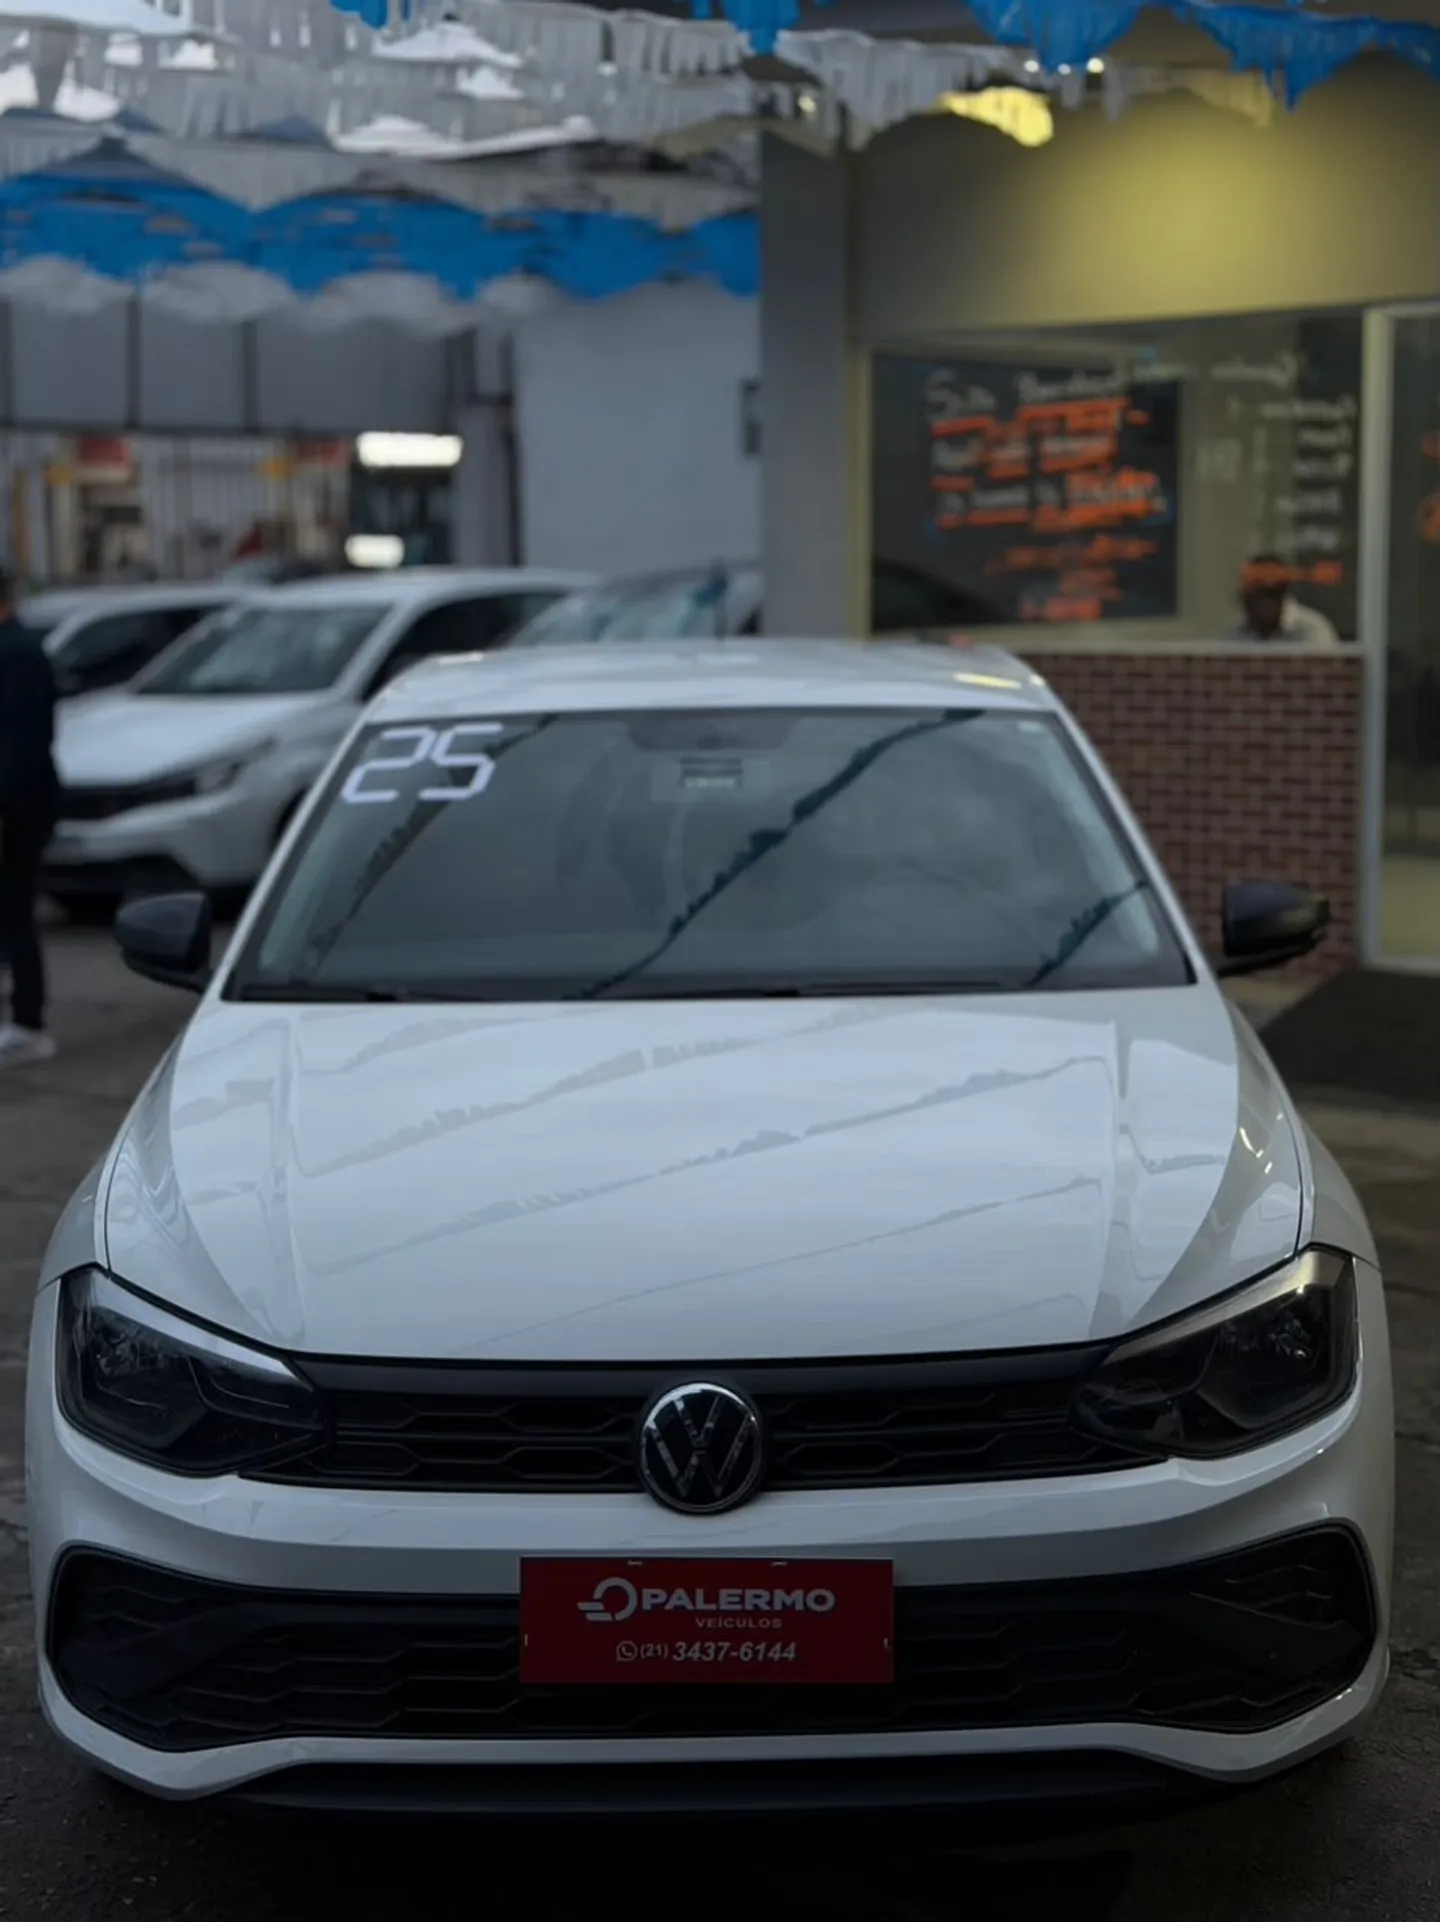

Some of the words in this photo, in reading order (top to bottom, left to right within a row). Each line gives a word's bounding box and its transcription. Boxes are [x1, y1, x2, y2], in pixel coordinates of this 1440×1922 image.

[341, 722, 504, 802] 25
[642, 1588, 836, 1612] PALERMO
[695, 1616, 783, 1629] VEÍCULOS
[639, 1642, 669, 1660] (21)
[672, 1641, 798, 1662] 3437-6144
